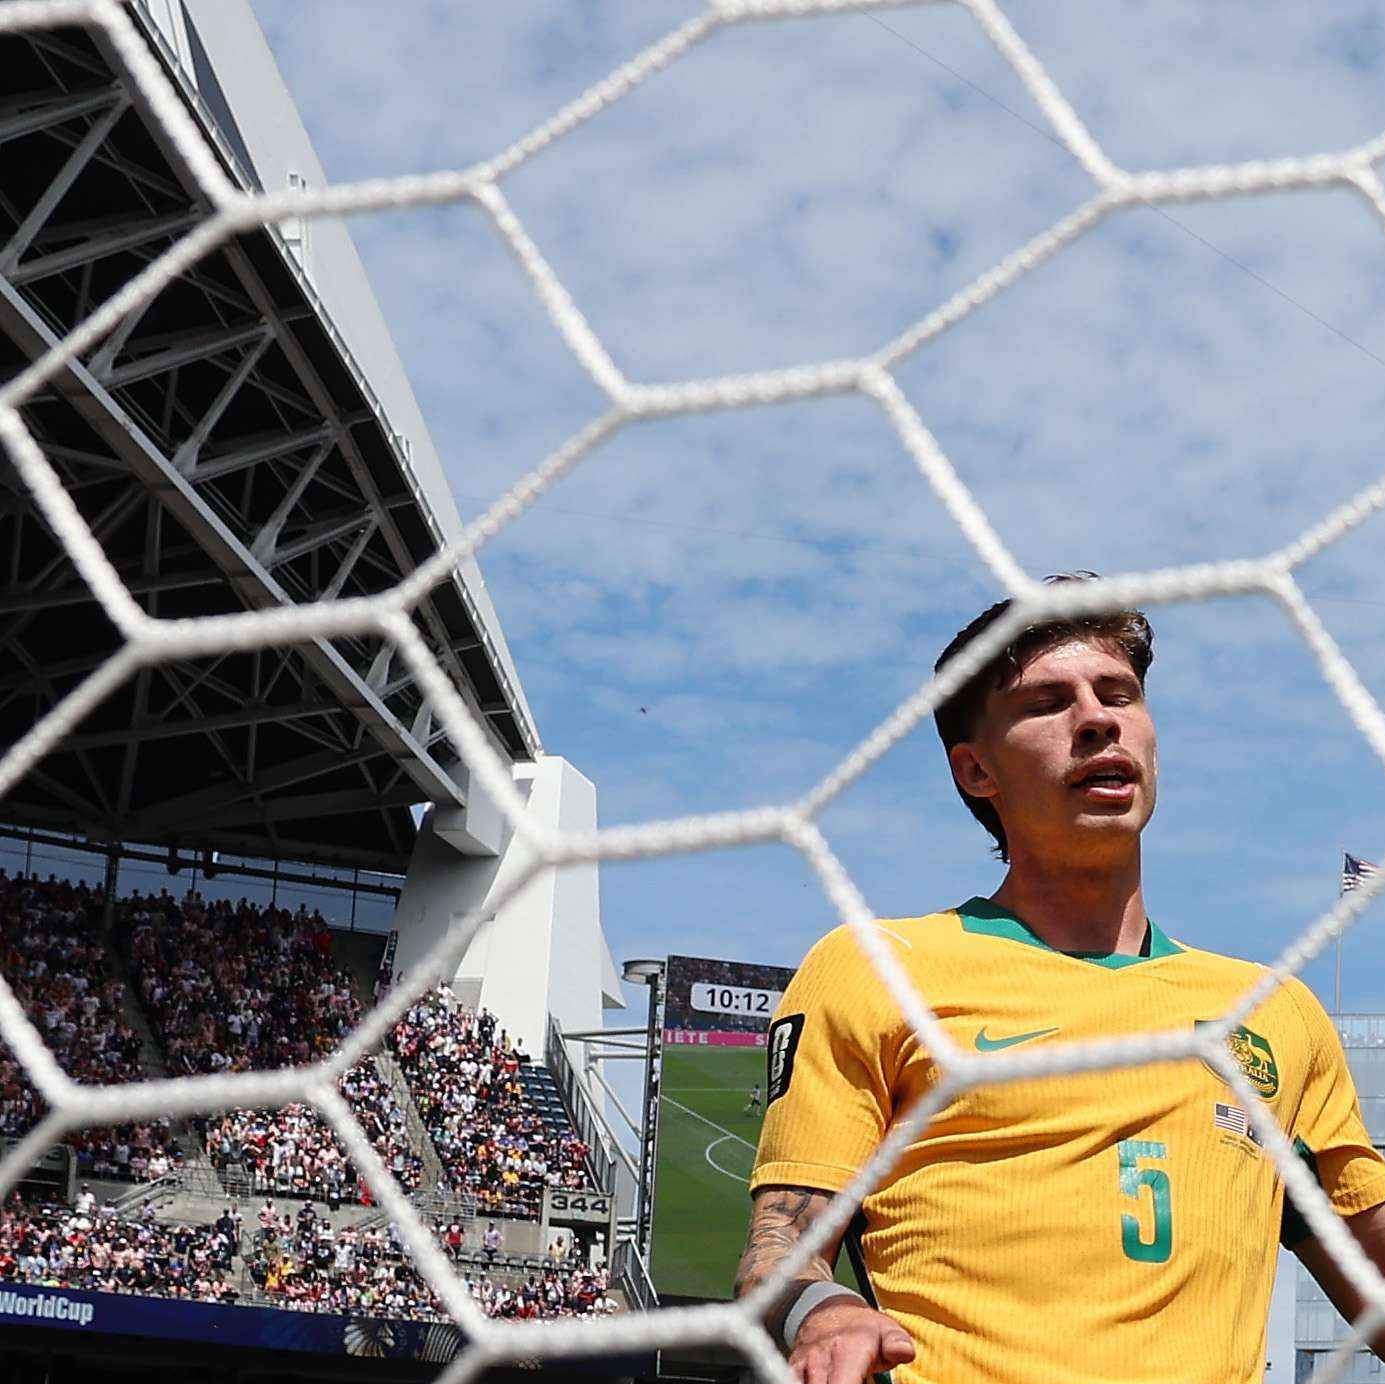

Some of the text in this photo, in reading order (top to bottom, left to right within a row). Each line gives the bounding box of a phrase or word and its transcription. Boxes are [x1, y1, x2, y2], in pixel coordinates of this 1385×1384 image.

[706, 987, 770, 1013] 10:12
[551, 1194, 609, 1215] 344
[1117, 1139, 1172, 1264] 5
